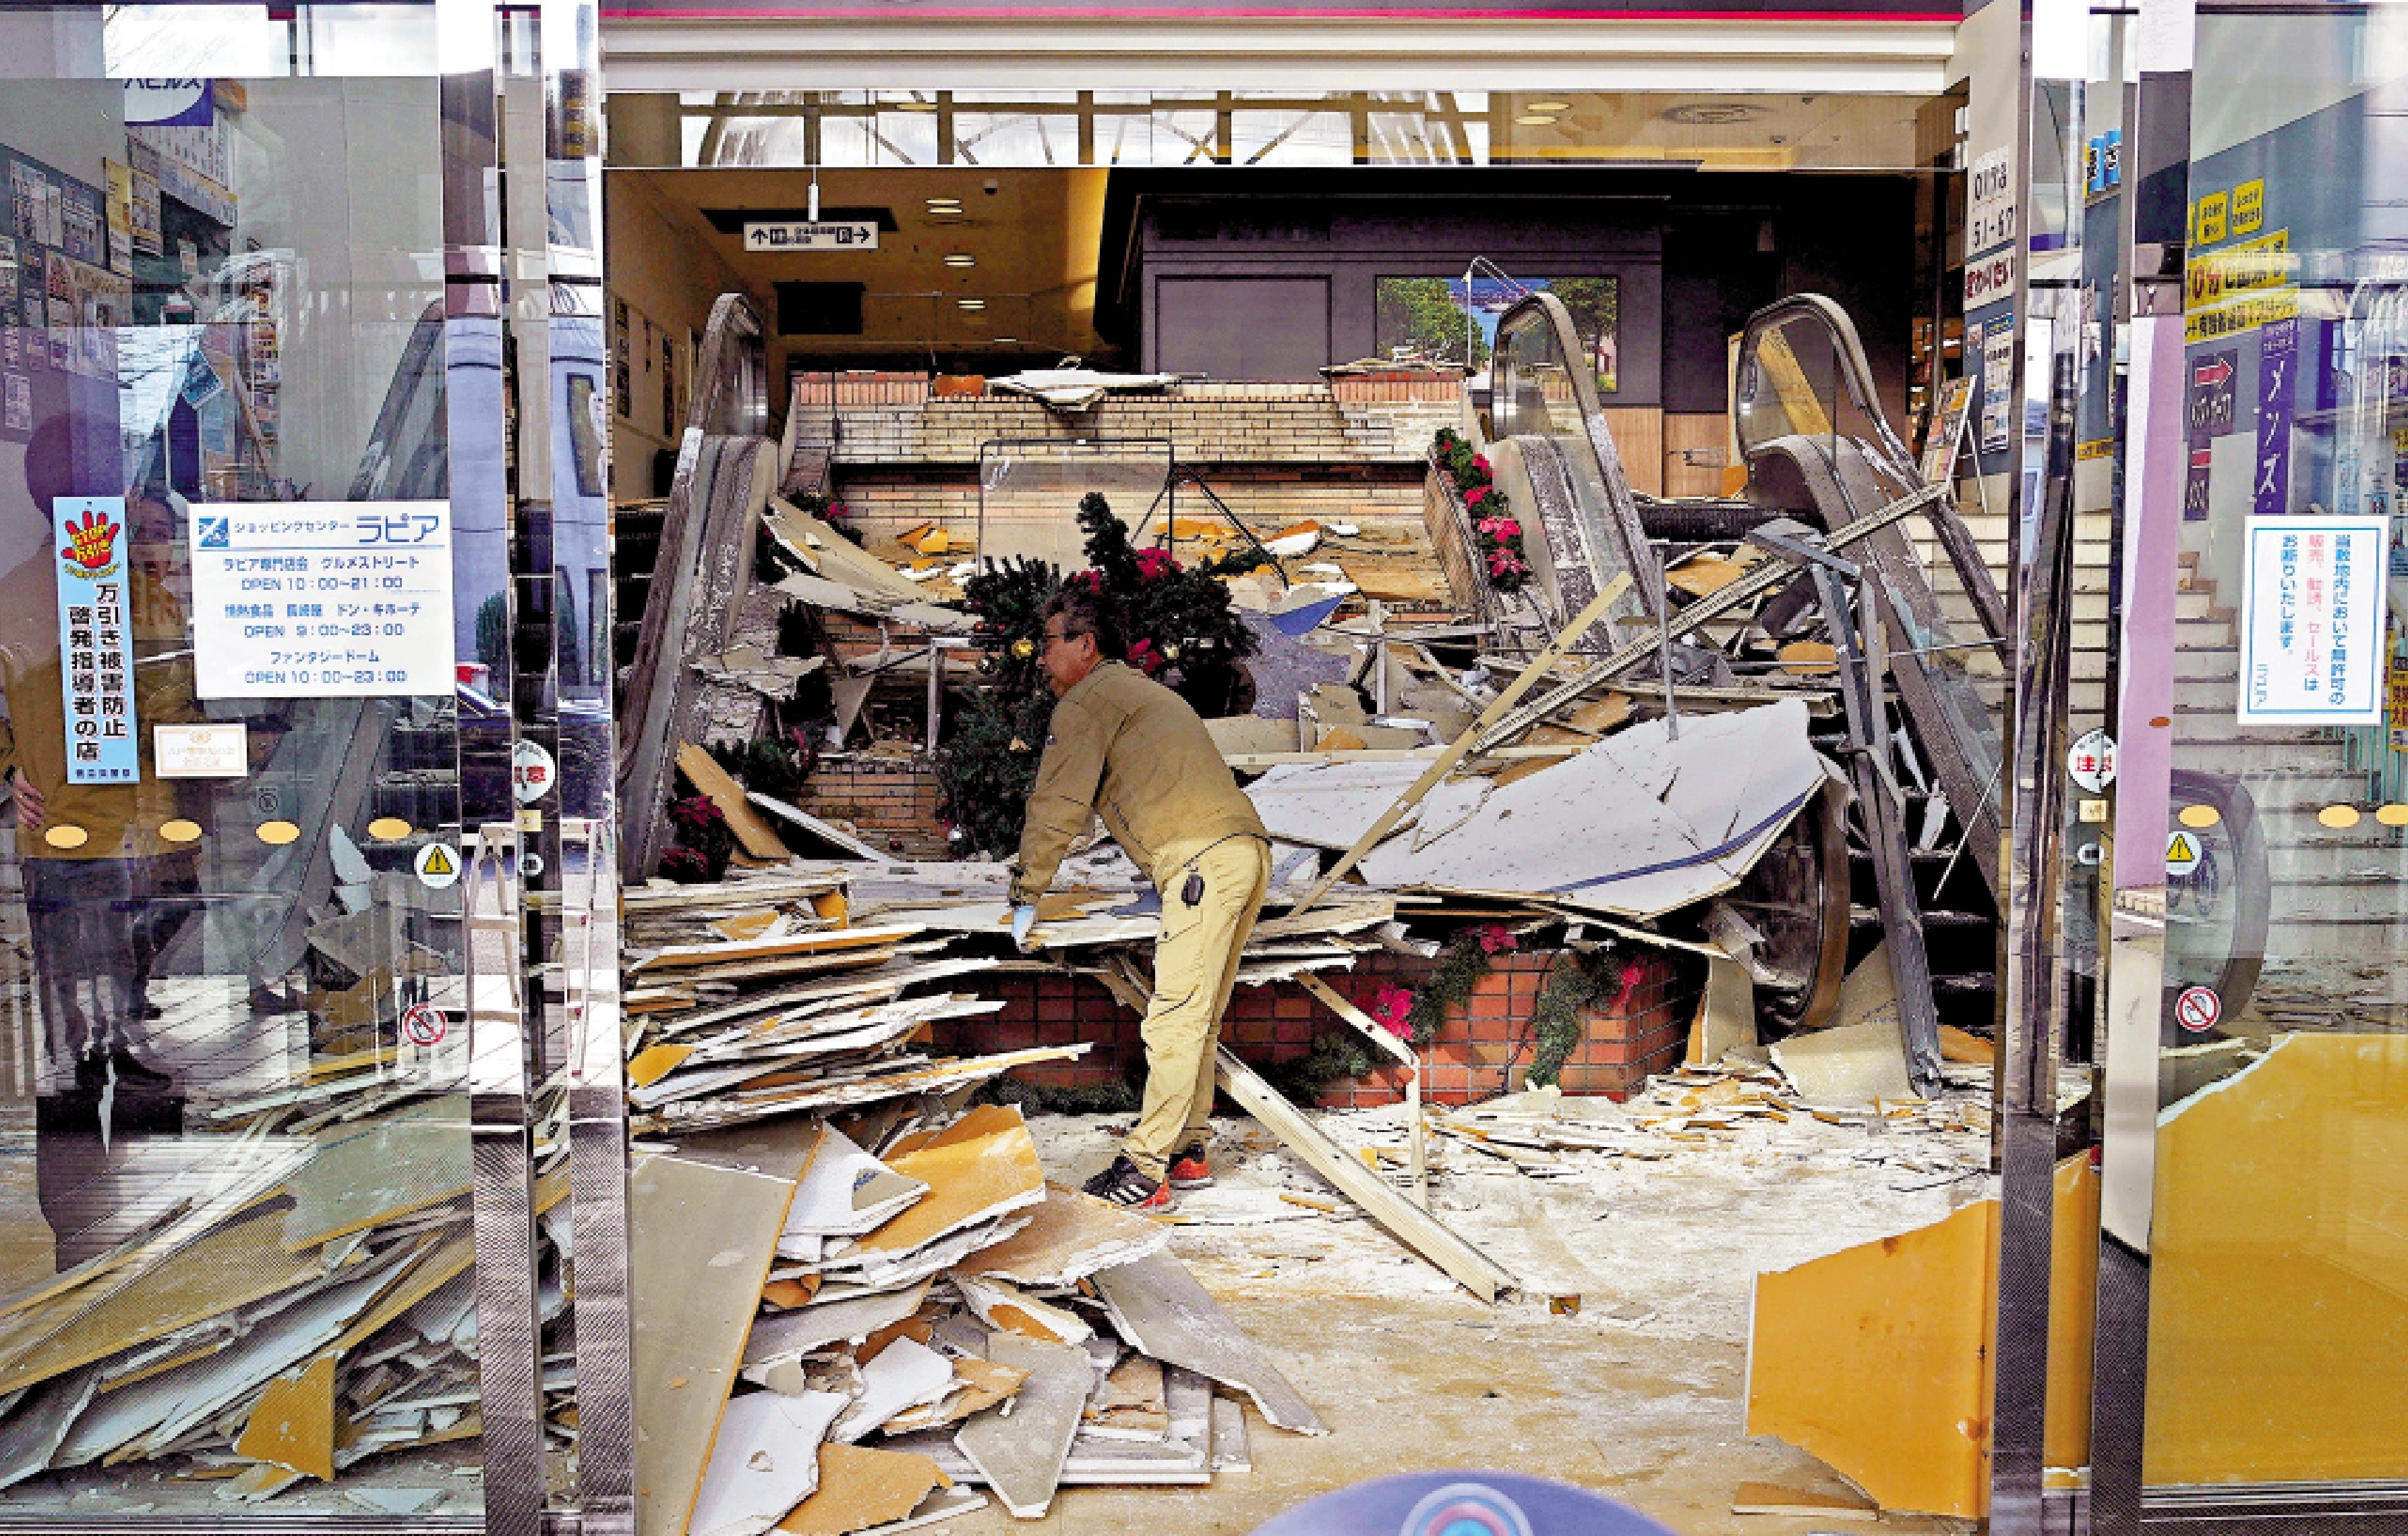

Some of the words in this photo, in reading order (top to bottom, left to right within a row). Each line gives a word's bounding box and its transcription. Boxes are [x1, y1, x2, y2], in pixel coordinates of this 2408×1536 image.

[234, 521, 350, 533] ショッピングセンター
[357, 513, 439, 543] ラピア
[223, 556, 310, 572] ラピア専門店会
[320, 556, 419, 571] グルメストリート
[241, 577, 282, 591] OPEN
[244, 625, 286, 639] OPEN
[96, 583, 127, 737] 万引き被害防止
[270, 649, 382, 665] ファンタジードーム
[69, 606, 100, 761] 啓発指導者の店
[244, 670, 286, 684] OPEN
